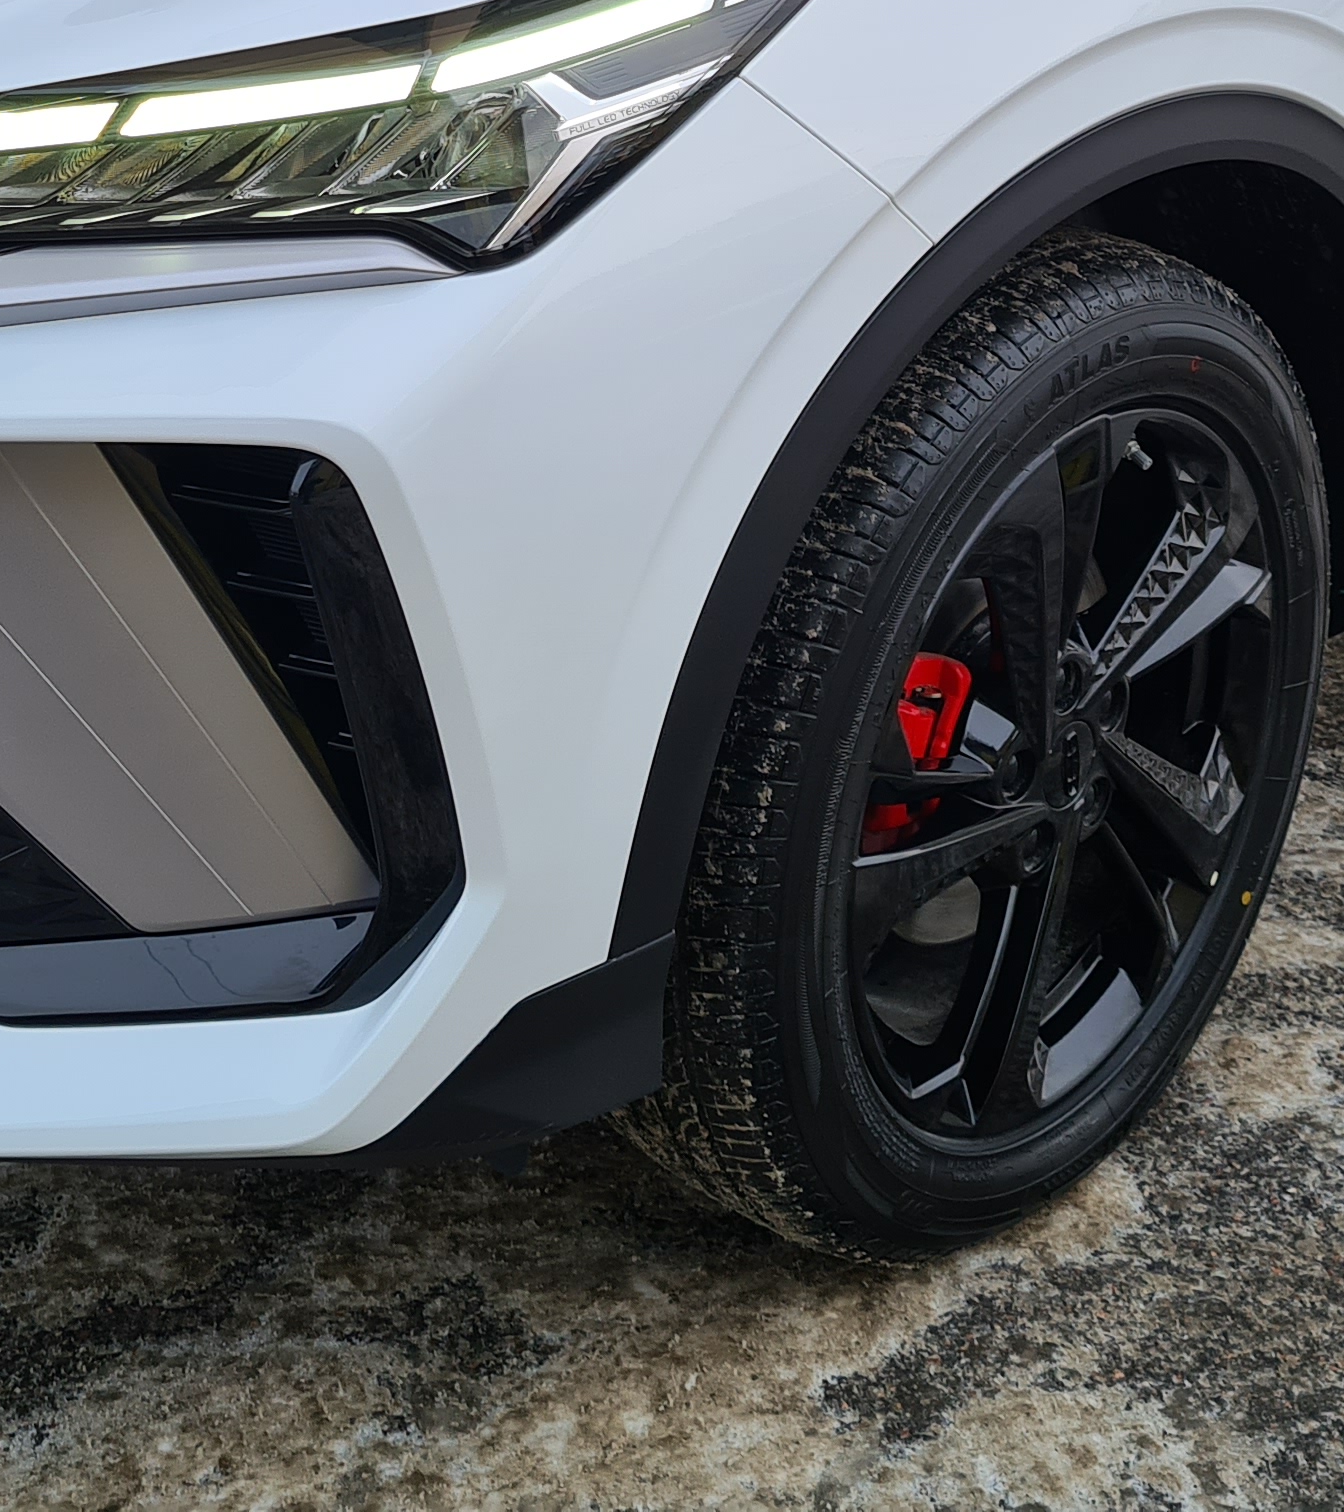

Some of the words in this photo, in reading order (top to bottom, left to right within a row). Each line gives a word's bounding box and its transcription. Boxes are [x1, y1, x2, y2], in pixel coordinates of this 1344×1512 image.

[569, 121, 595, 135] FULL
[597, 113, 617, 126] LED
[620, 90, 680, 118] TECHNOLOGY
[1048, 335, 1131, 405] ATLAS
